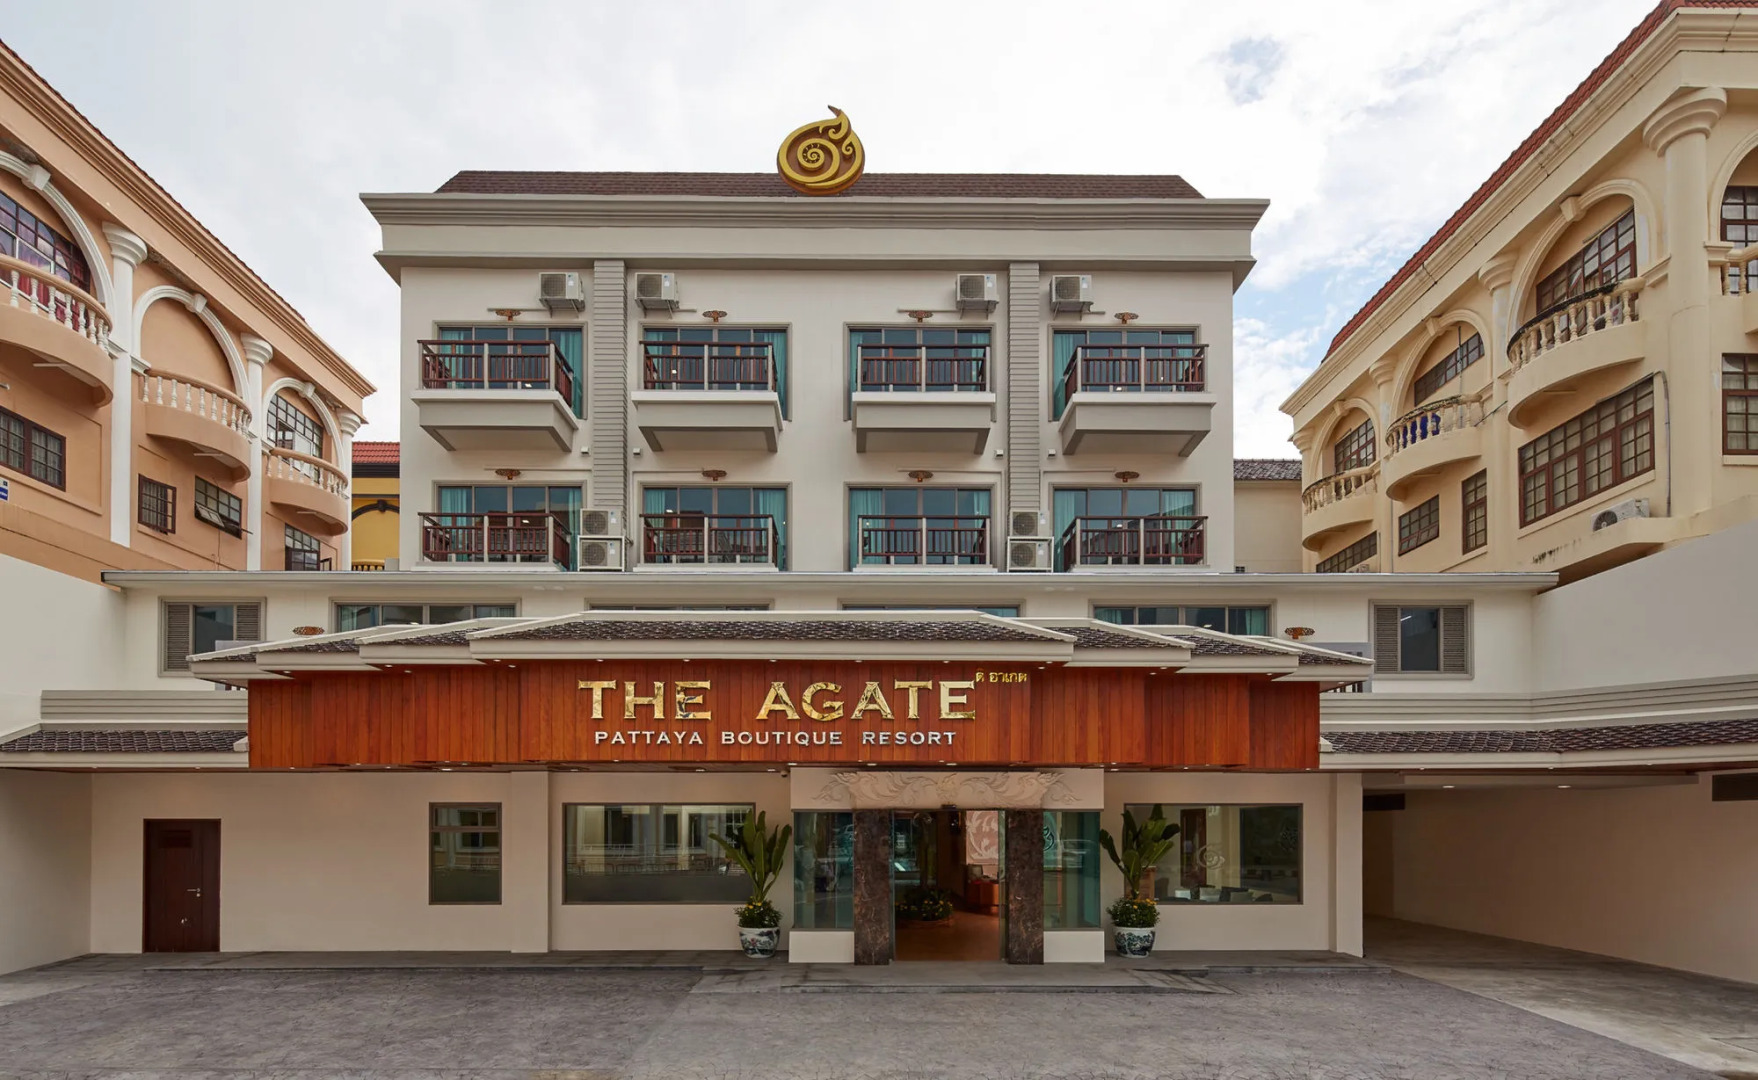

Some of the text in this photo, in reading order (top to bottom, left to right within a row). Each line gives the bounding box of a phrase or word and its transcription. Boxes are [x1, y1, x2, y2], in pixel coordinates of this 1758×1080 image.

[578, 679, 976, 722] THE AGATE
[594, 731, 957, 748] PATTAYA BOUTIQUE RESORT
